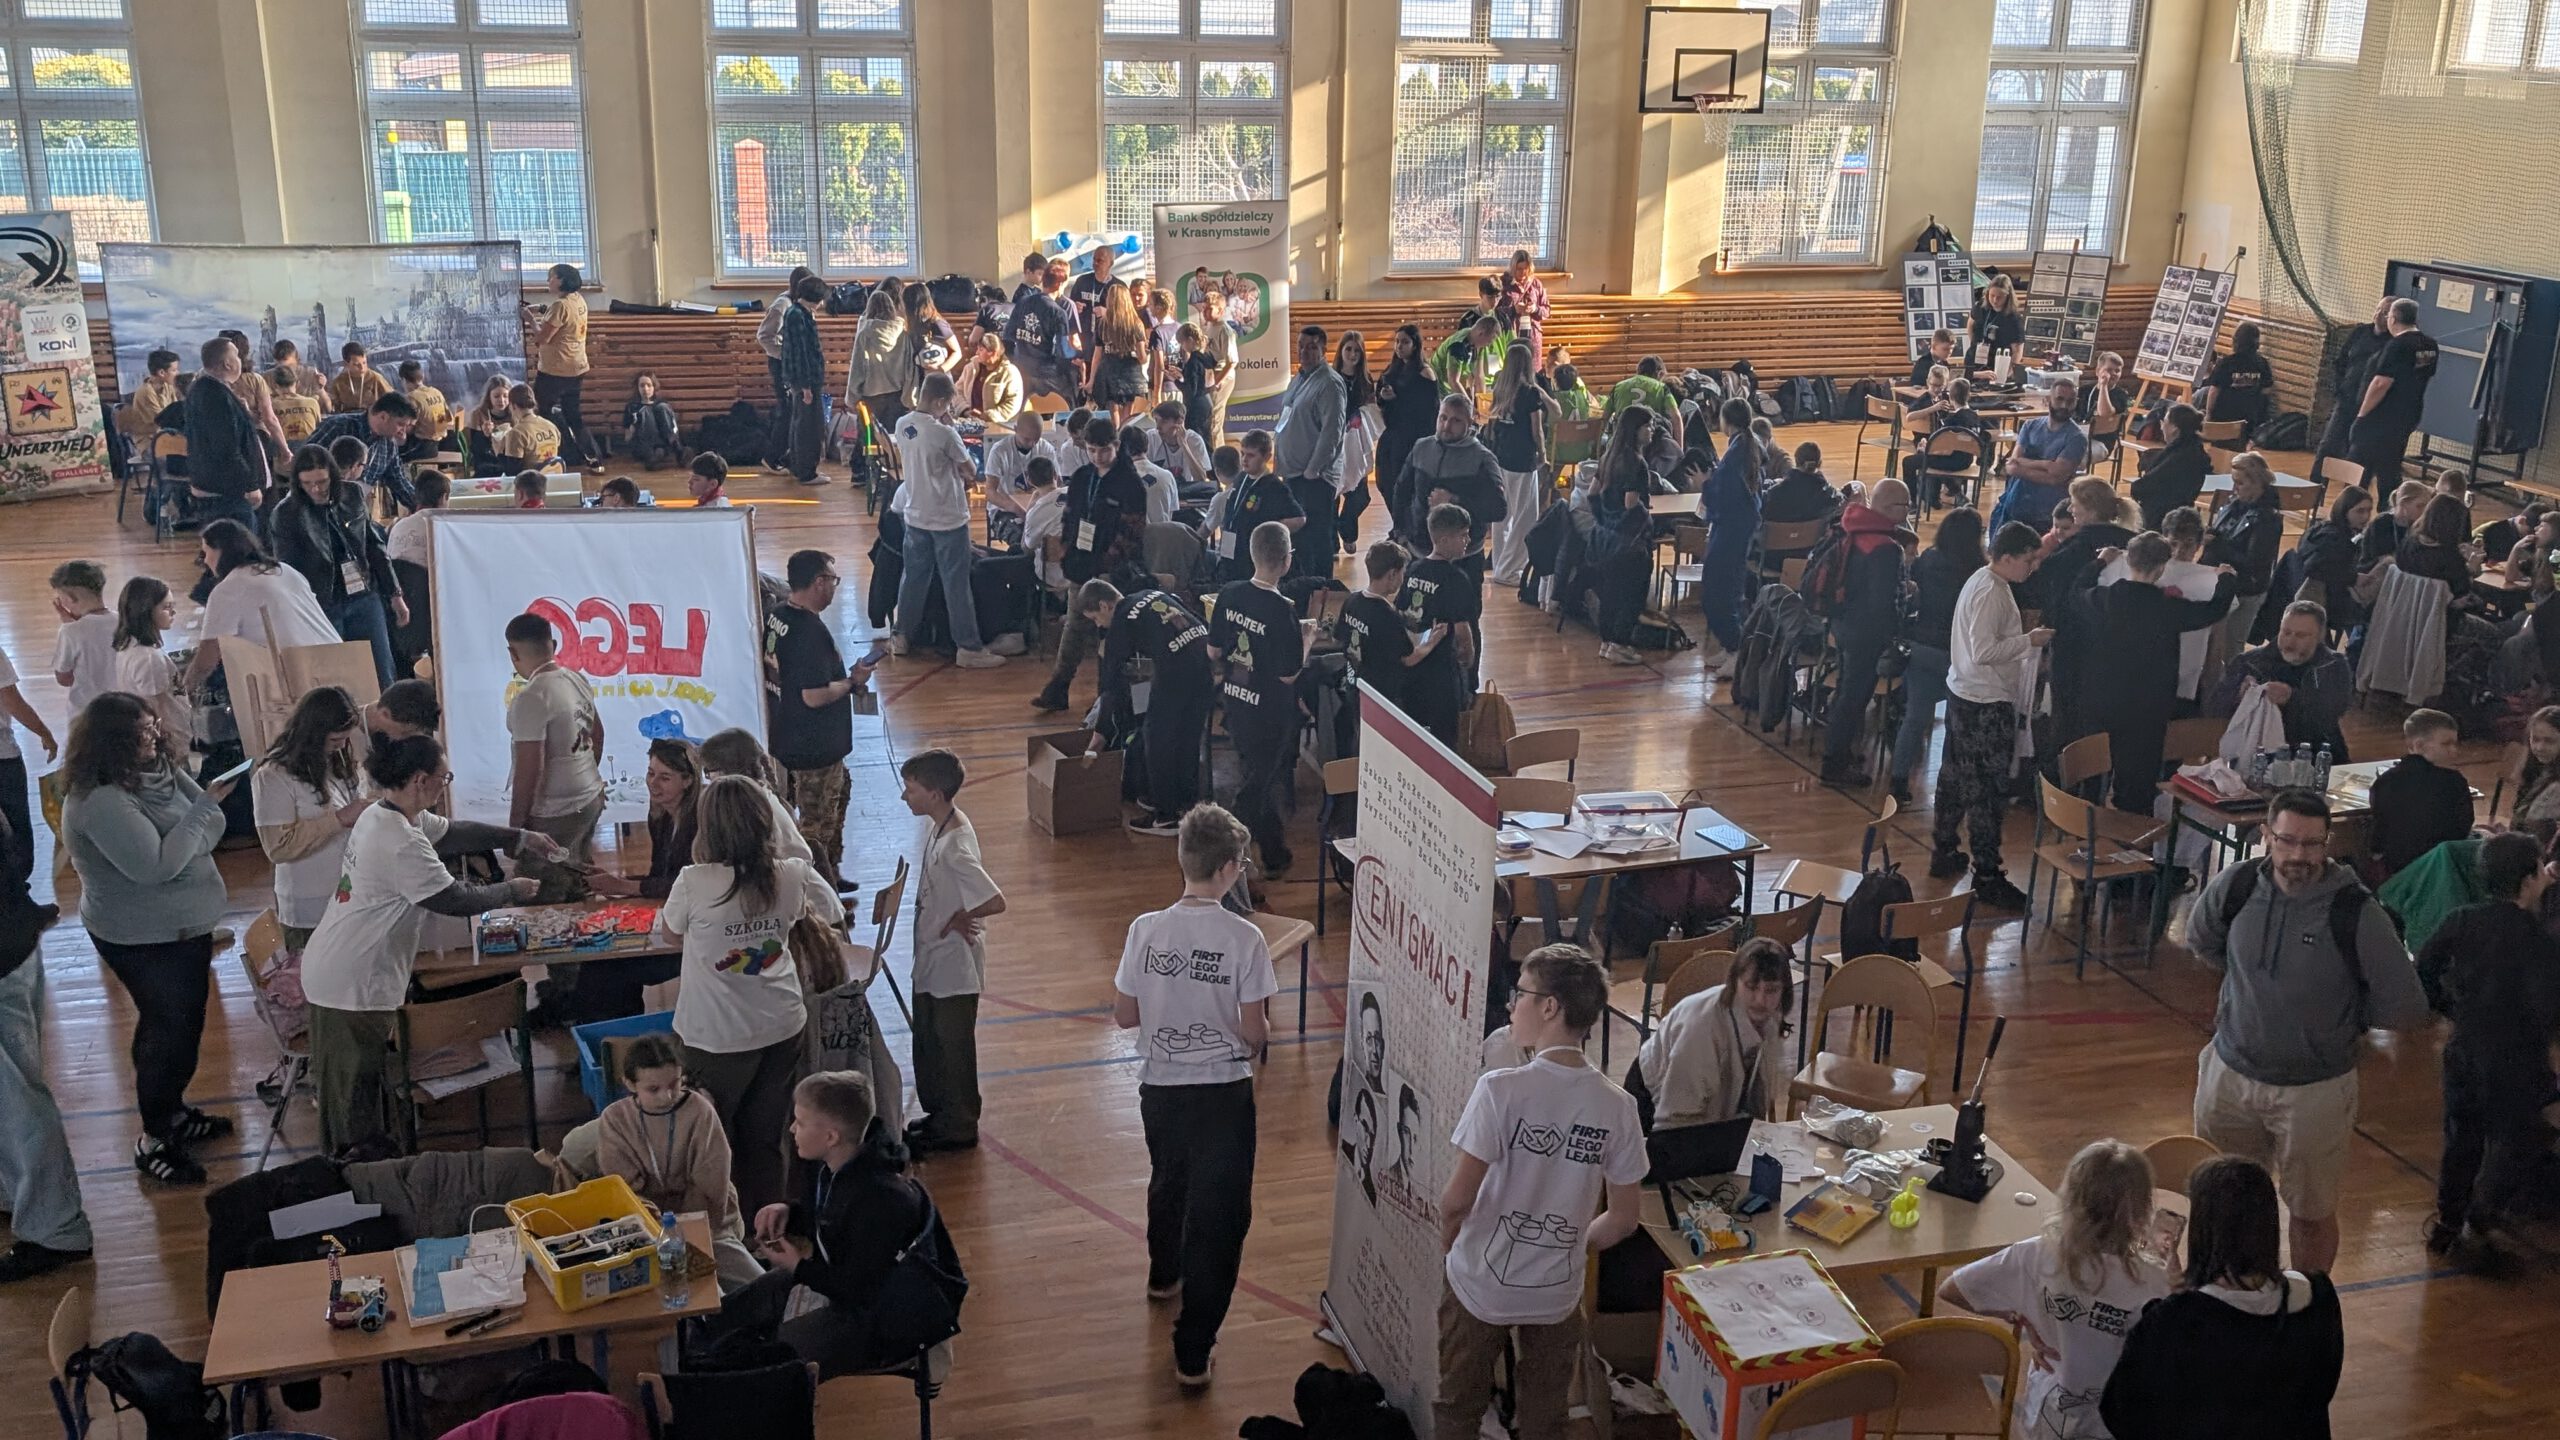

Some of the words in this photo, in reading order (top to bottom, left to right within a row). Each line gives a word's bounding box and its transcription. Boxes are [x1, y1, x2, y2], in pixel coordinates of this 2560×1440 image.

[1168, 212, 1198, 223] Bank
[1201, 210, 1274, 225] Spółdzielczy
[1168, 230, 1178, 238] w
[1181, 226, 1271, 240] Krasnymstawie
[1016, 328, 1042, 344] STELLA
[1238, 357, 1279, 370] okoleń
[426, 395, 443, 406] MAX
[535, 428, 555, 444] OLA
[0, 435, 95, 460] UNEARTHED
[54, 467, 101, 479] CHALLENGE
[1225, 608, 1267, 637] WOJTEK
[1168, 624, 1209, 653] SHREKI
[1223, 681, 1260, 706] HREKI
[1396, 771, 1443, 819] Społeczna
[1363, 761, 1393, 794] Szkoła
[1398, 790, 1447, 844] Podstawowa
[1453, 844, 1465, 859] nr
[1469, 857, 1476, 870] 2
[1377, 791, 1417, 834] Polskich
[1421, 831, 1482, 893] Matematyków
[724, 917, 783, 937] SZKOŁA
[1190, 948, 1225, 963] FIRST
[1189, 959, 1219, 973] LEGO
[1189, 970, 1232, 985] LEAGUE
[1570, 1123, 1610, 1141] FIRST
[1567, 1136, 1603, 1152] LEGO
[2091, 1300, 2132, 1320] FIRST
[2089, 1310, 2125, 1327] LEGO
